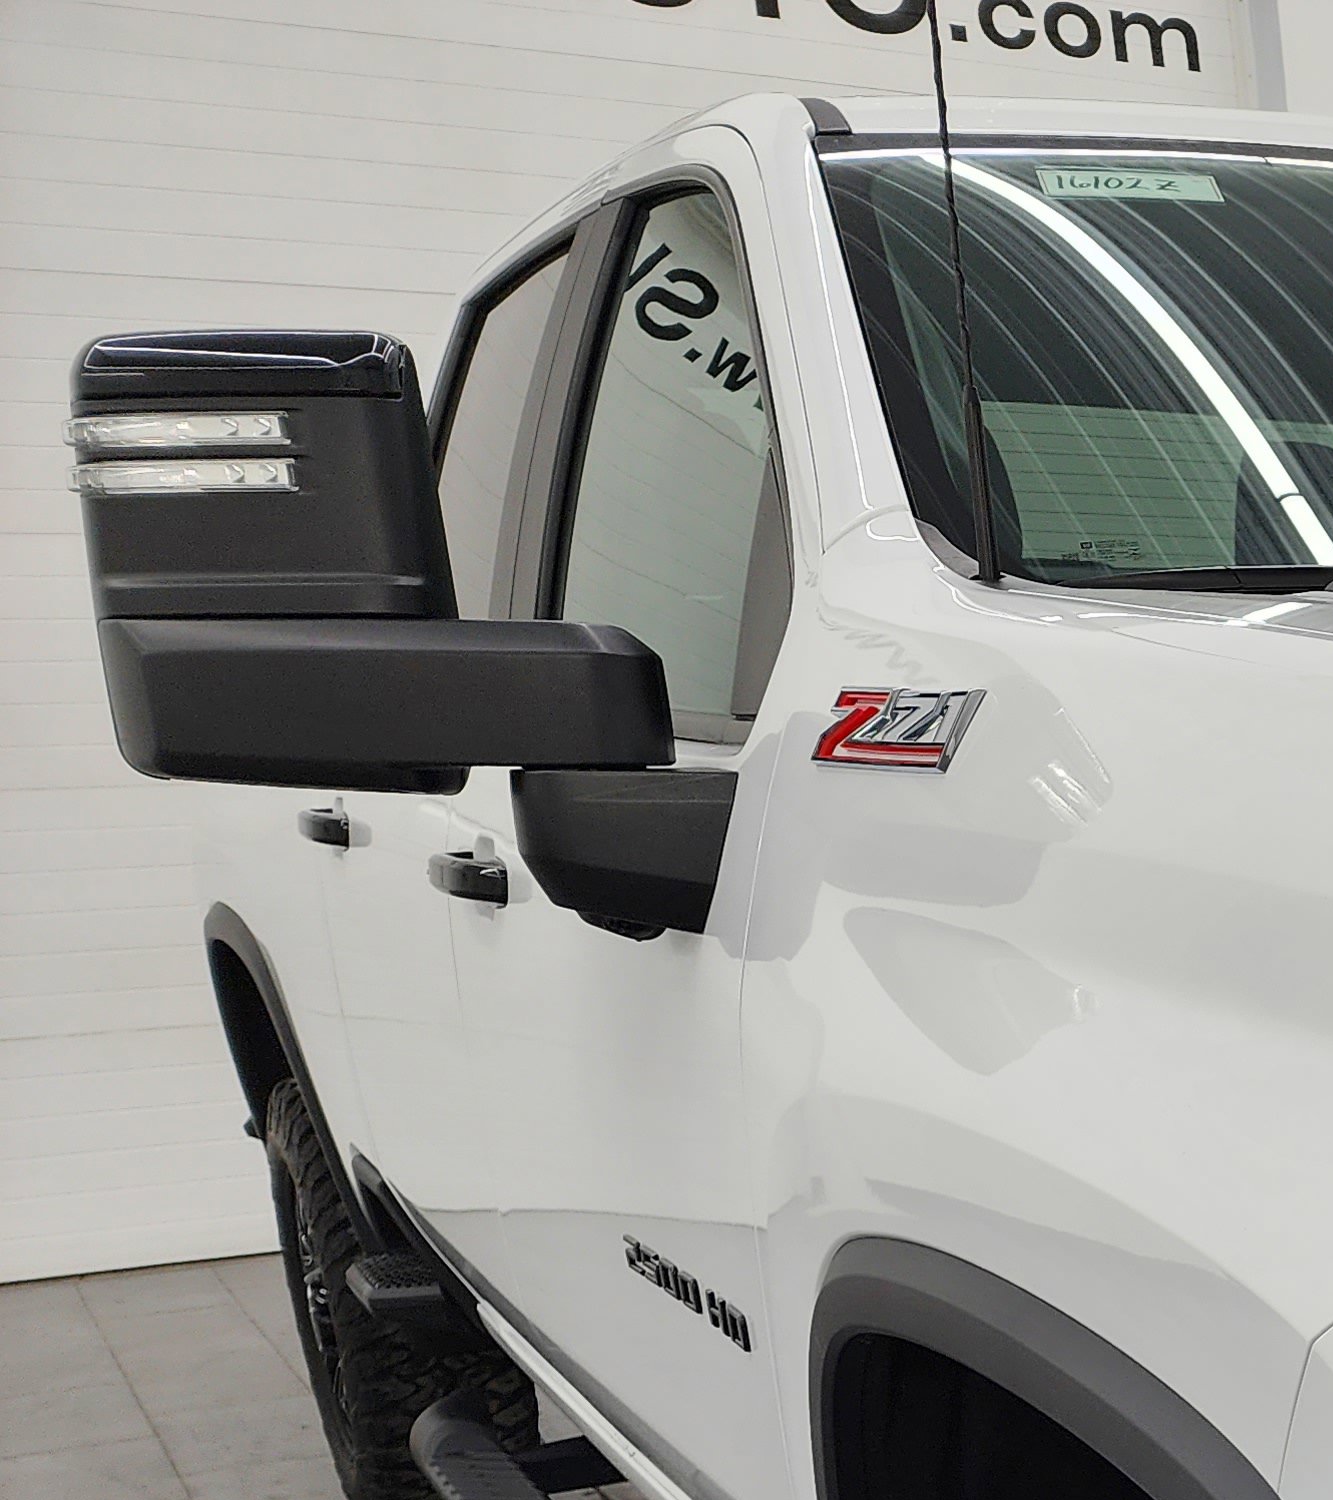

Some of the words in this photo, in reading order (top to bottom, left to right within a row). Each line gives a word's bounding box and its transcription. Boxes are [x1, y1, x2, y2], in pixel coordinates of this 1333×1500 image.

[754, 0, 1202, 73] .com
[811, 686, 988, 775] Z71
[622, 1233, 703, 1315] 2500
[705, 1289, 752, 1353] HD
